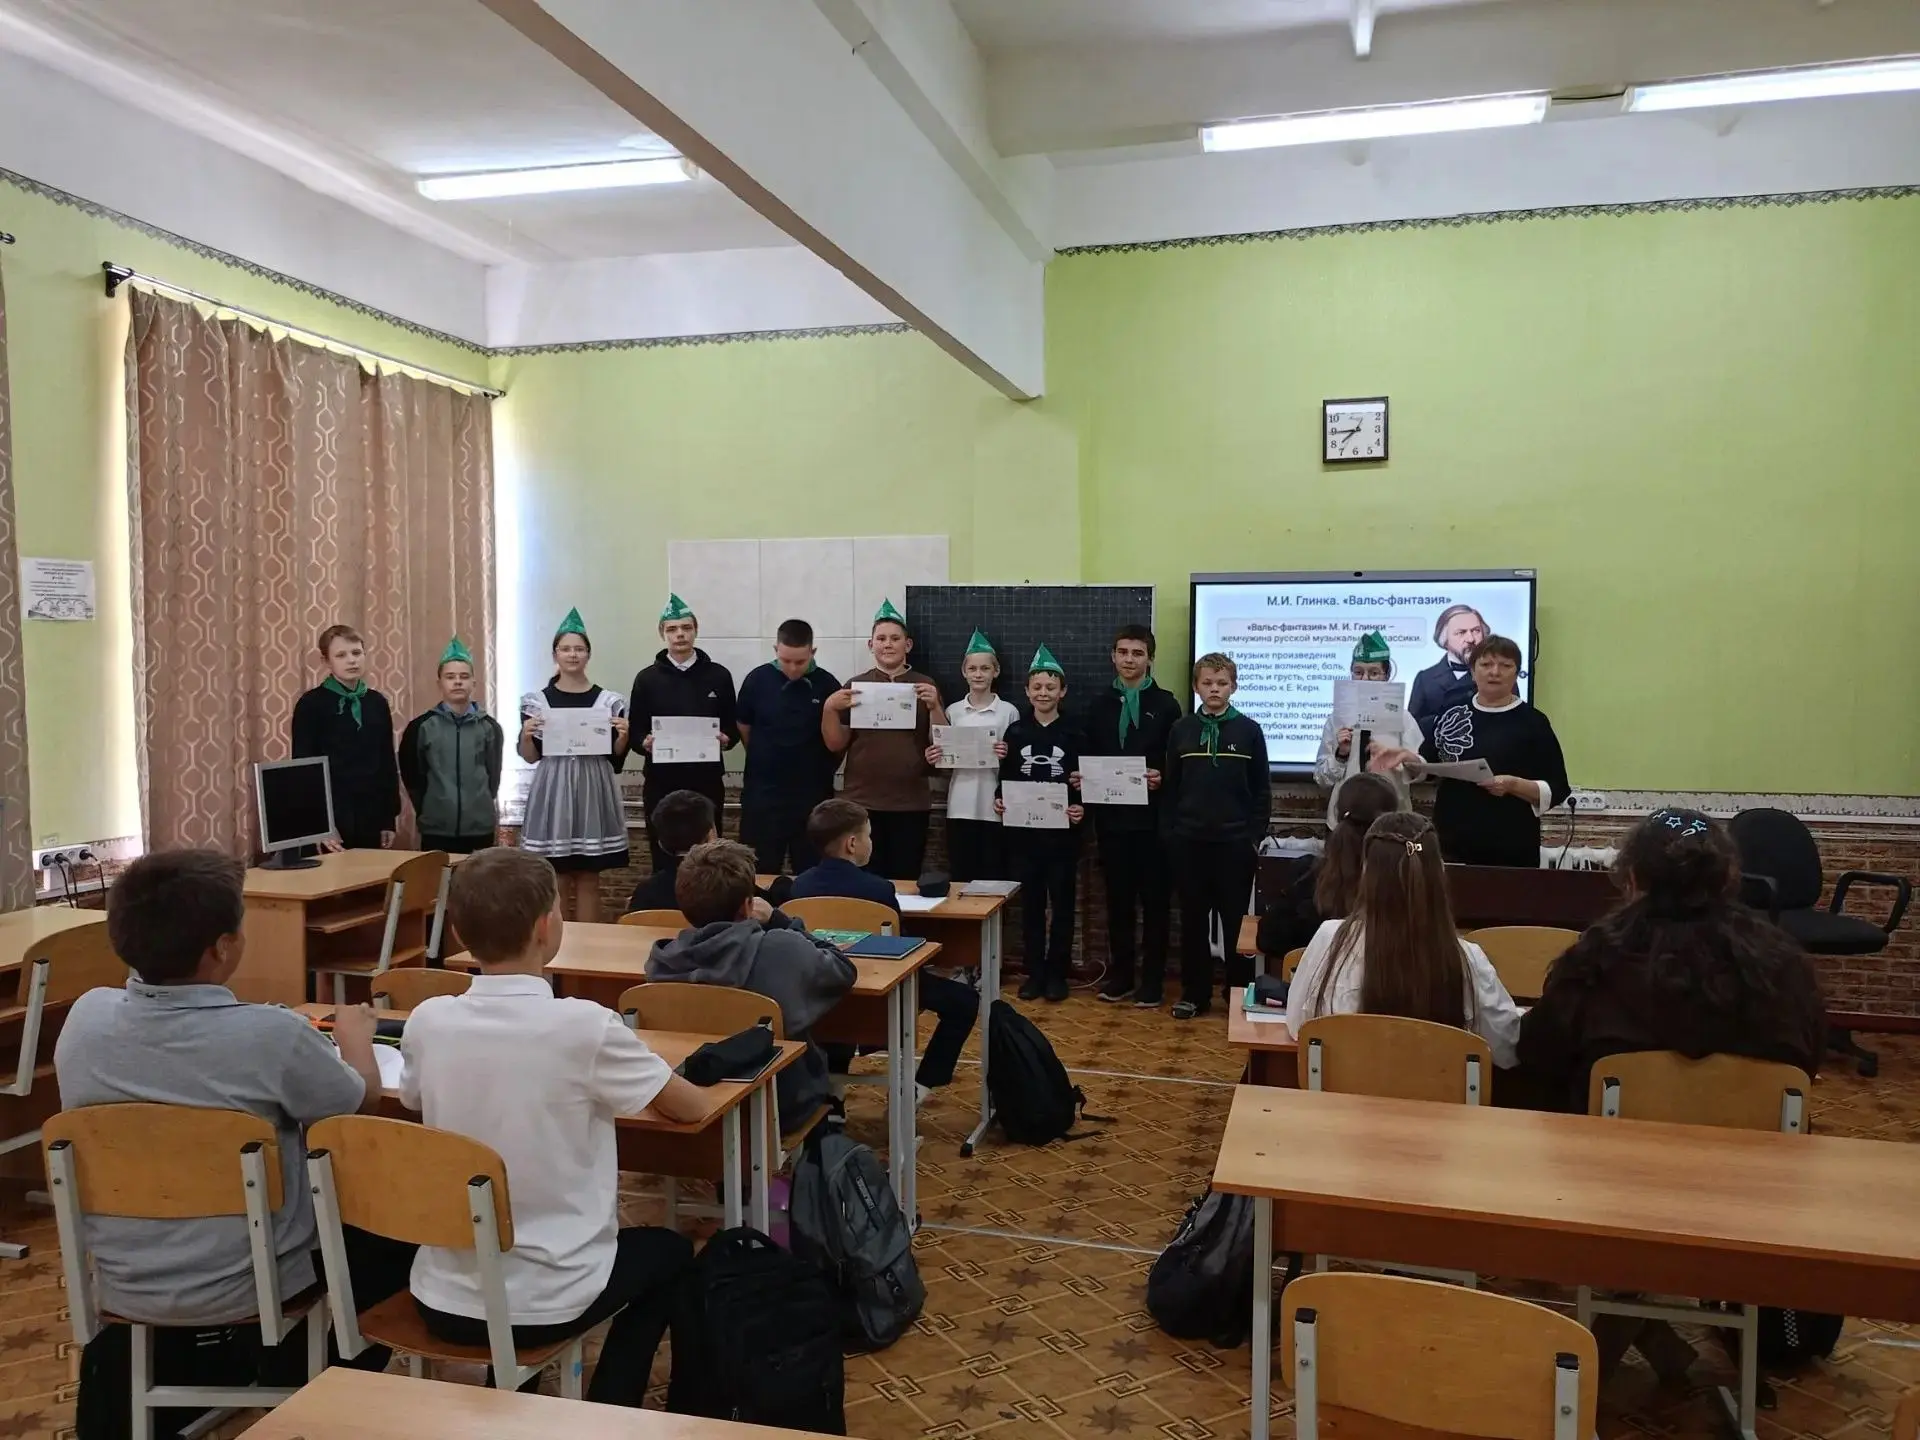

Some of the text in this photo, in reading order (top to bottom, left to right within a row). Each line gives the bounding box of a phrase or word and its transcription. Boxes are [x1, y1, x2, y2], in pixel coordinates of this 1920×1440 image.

[1329, 414, 1339, 423] 10
[1375, 412, 1381, 421] 2
[1331, 427, 1337, 435] 9
[1374, 425, 1381, 433] 3
[1330, 440, 1337, 448] 8
[1374, 438, 1381, 446] 4
[1339, 448, 1345, 456] 7
[1352, 447, 1359, 455] 6
[1367, 447, 1373, 455] 5
[1267, 594, 1452, 607] М.И. Глинка. «Вальс-фантазия»
[1247, 622, 1327, 633] «Вальс-фантазия»
[1353, 622, 1386, 631] Глинки
[1221, 635, 1272, 644] жемчужина
[1274, 634, 1310, 644] русской
[1236, 652, 1270, 661] музыке
[1272, 652, 1337, 660] произведения
[1275, 663, 1320, 671] волнение,
[1273, 674, 1305, 682] грусть,
